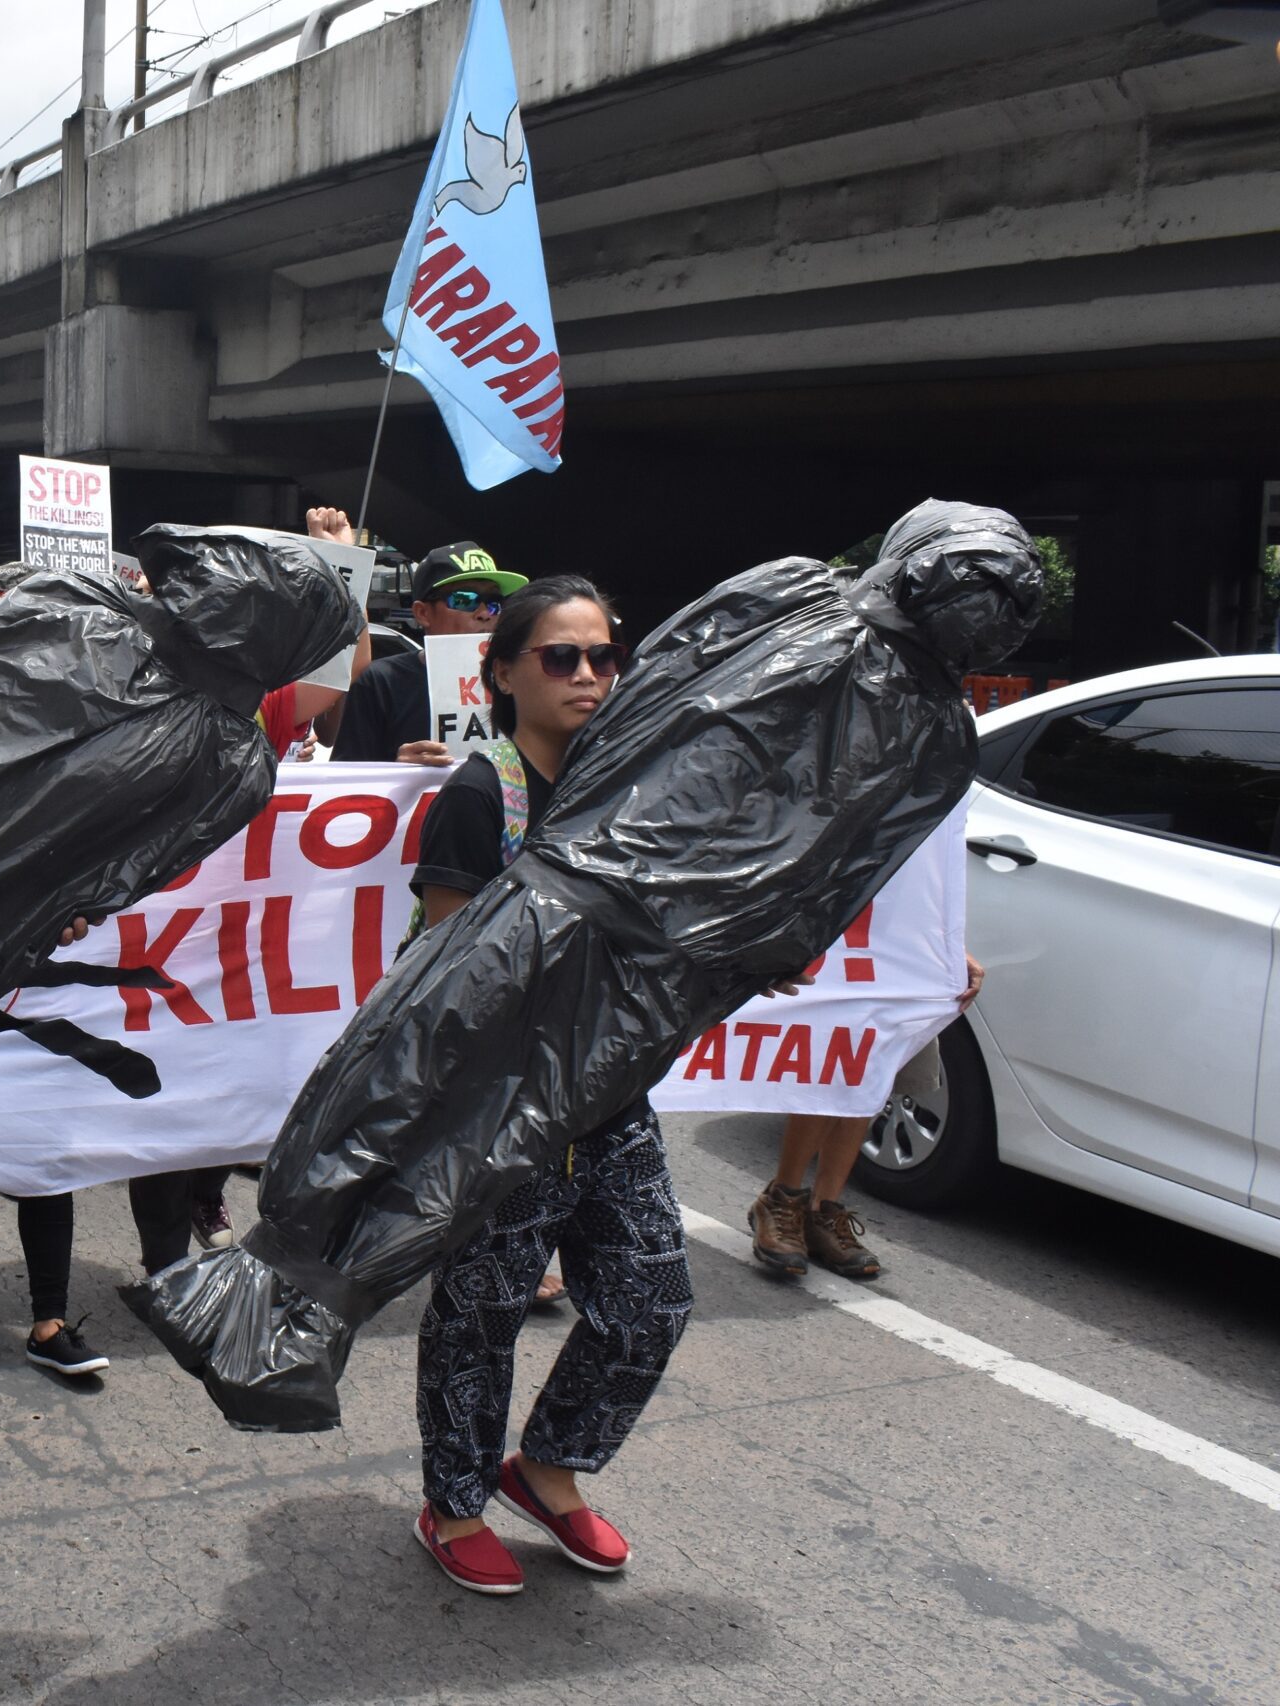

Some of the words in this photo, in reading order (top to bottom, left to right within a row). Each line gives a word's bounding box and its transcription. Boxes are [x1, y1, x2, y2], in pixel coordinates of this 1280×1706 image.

[28, 464, 102, 507] STOP
[27, 504, 49, 522] THE
[50, 507, 104, 527] KILLINGS!
[25, 533, 55, 551] STOP
[55, 536, 79, 553] THE
[79, 538, 106, 555] WAR
[27, 551, 47, 567] VS.
[48, 553, 70, 570] THE
[71, 555, 105, 572] POOR!
